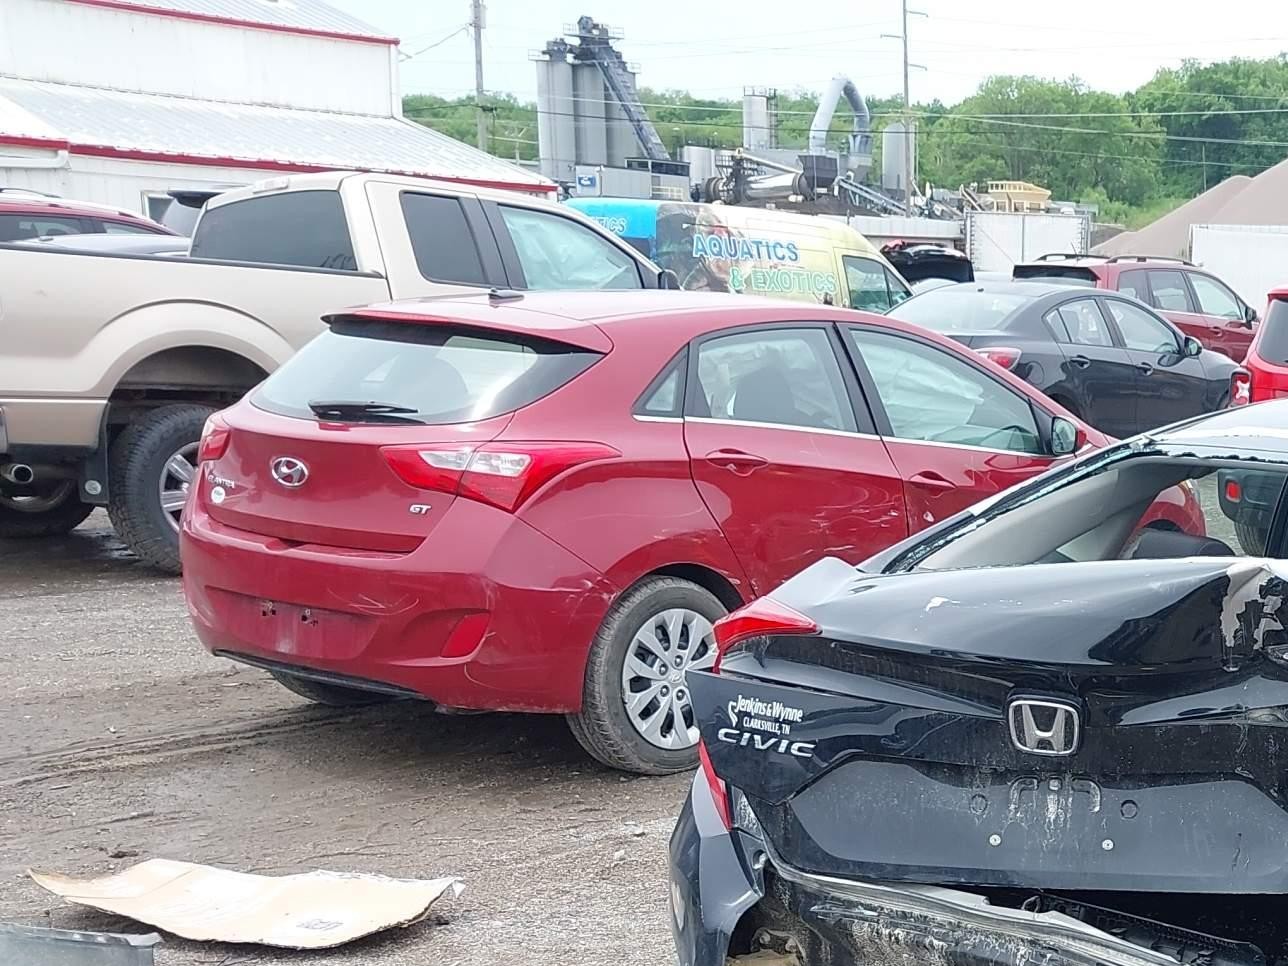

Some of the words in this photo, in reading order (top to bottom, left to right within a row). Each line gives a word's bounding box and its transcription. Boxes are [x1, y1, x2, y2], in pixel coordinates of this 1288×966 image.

[692, 234, 799, 262] AQUATICS
[730, 266, 745, 290] &
[751, 268, 837, 293] EXOTICS
[409, 504, 431, 515] GT
[781, 723, 791, 735] TN
[717, 728, 817, 758] CIVIC
